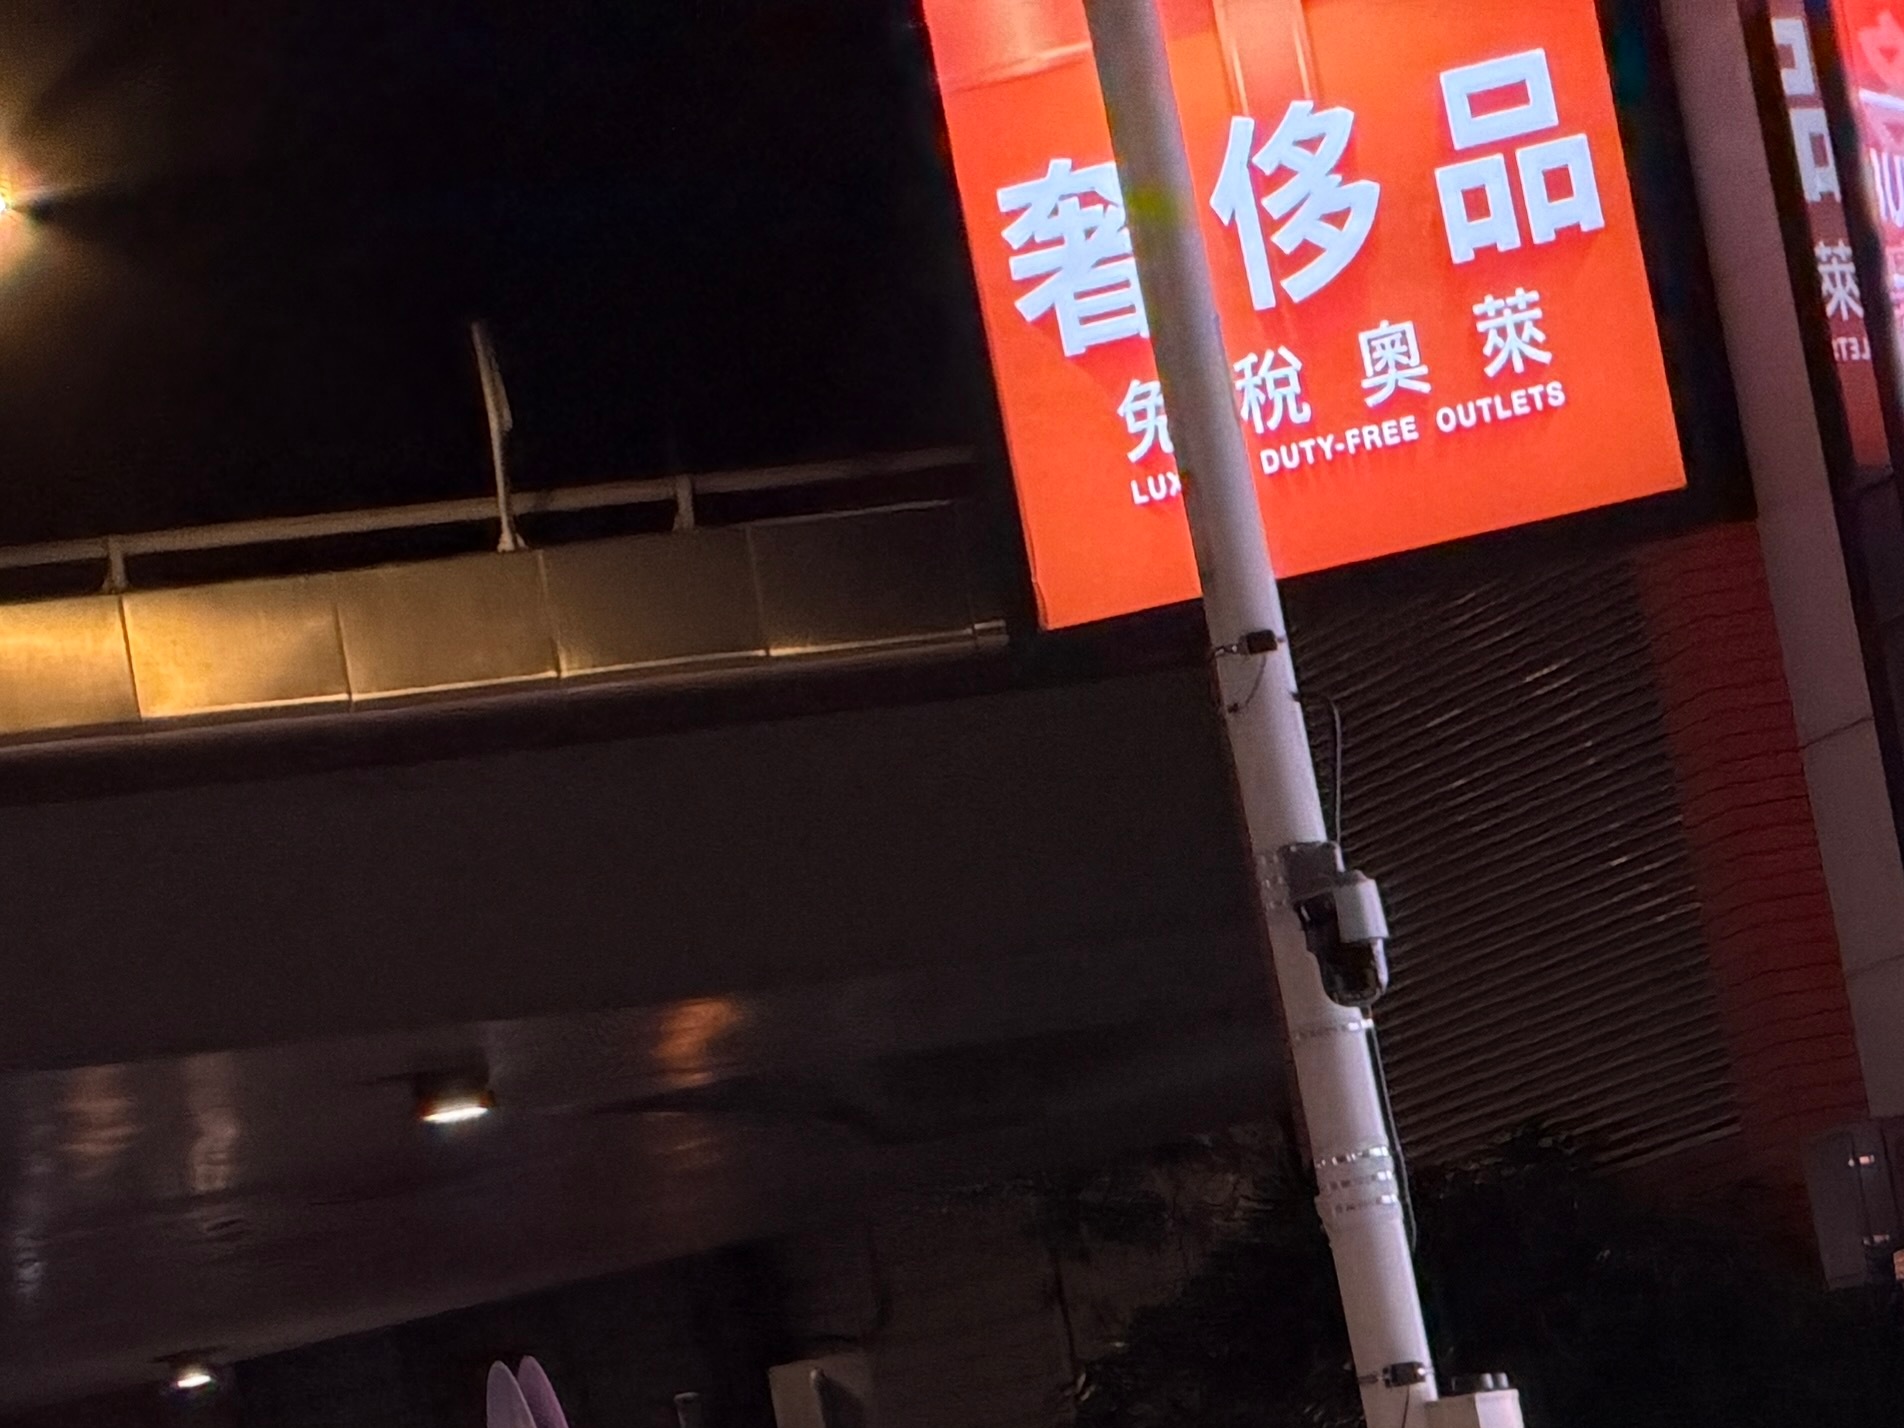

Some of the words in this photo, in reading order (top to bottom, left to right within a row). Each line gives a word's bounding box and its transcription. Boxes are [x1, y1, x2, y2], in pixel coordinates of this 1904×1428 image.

[997, 47, 1605, 358] 奢侈品
[1117, 287, 1552, 463] 免稅奧萊
[1130, 470, 1182, 505] LUX
[1259, 415, 1420, 475] DUTY-FREE
[1435, 381, 1567, 434] OUTLETS
